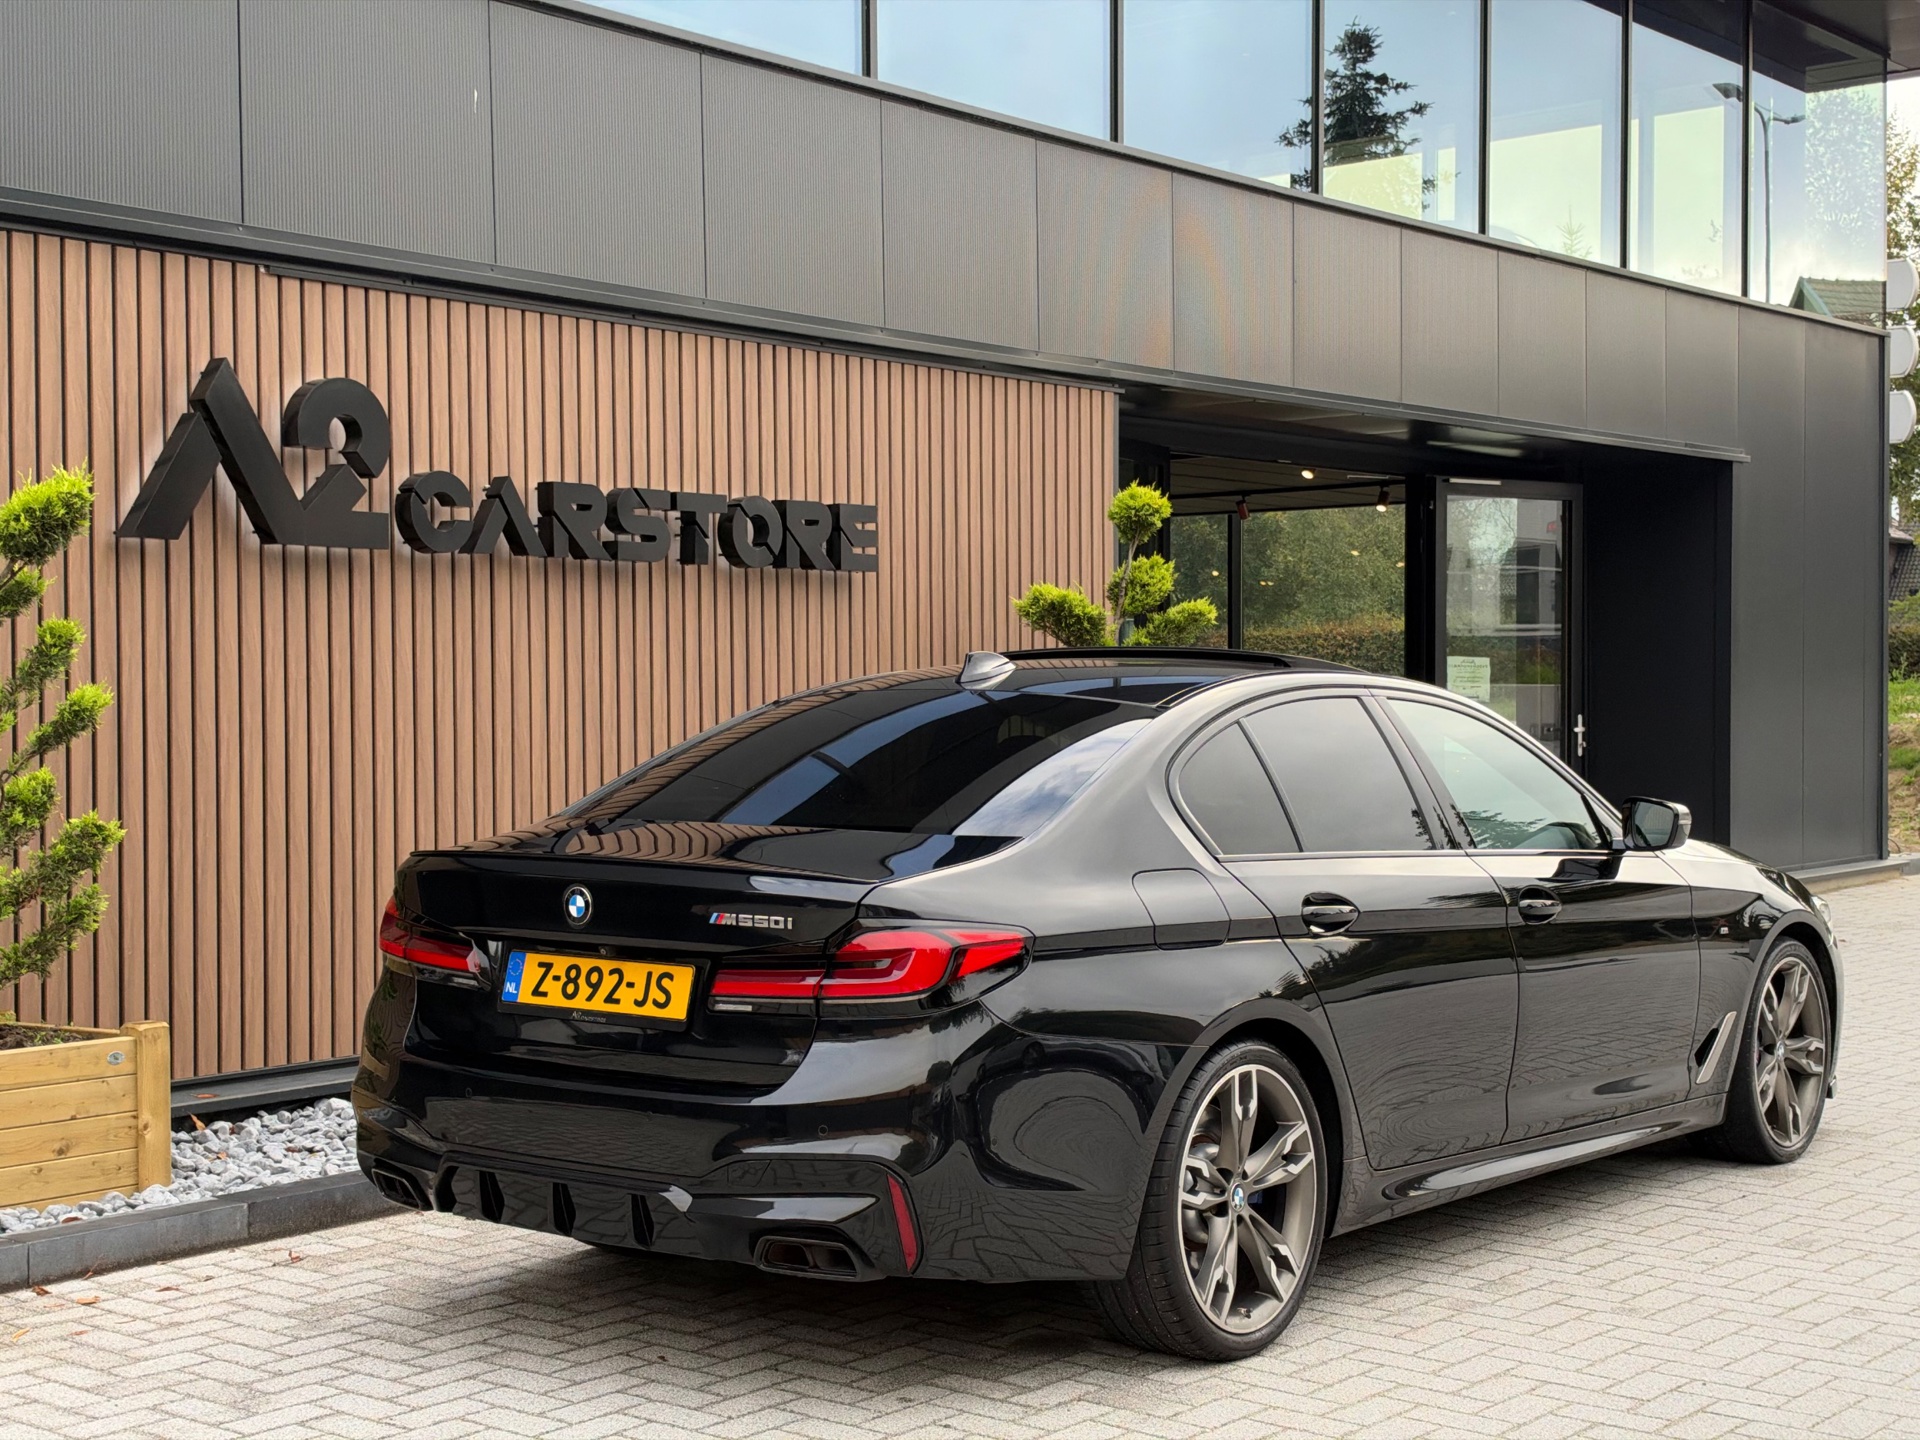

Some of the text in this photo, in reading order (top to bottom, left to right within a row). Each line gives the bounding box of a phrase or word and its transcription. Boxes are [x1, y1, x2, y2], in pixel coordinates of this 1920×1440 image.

[116, 357, 878, 573] A2 CARSTORE
[505, 981, 518, 994] NL
[530, 961, 674, 1010] Z-892-JS
